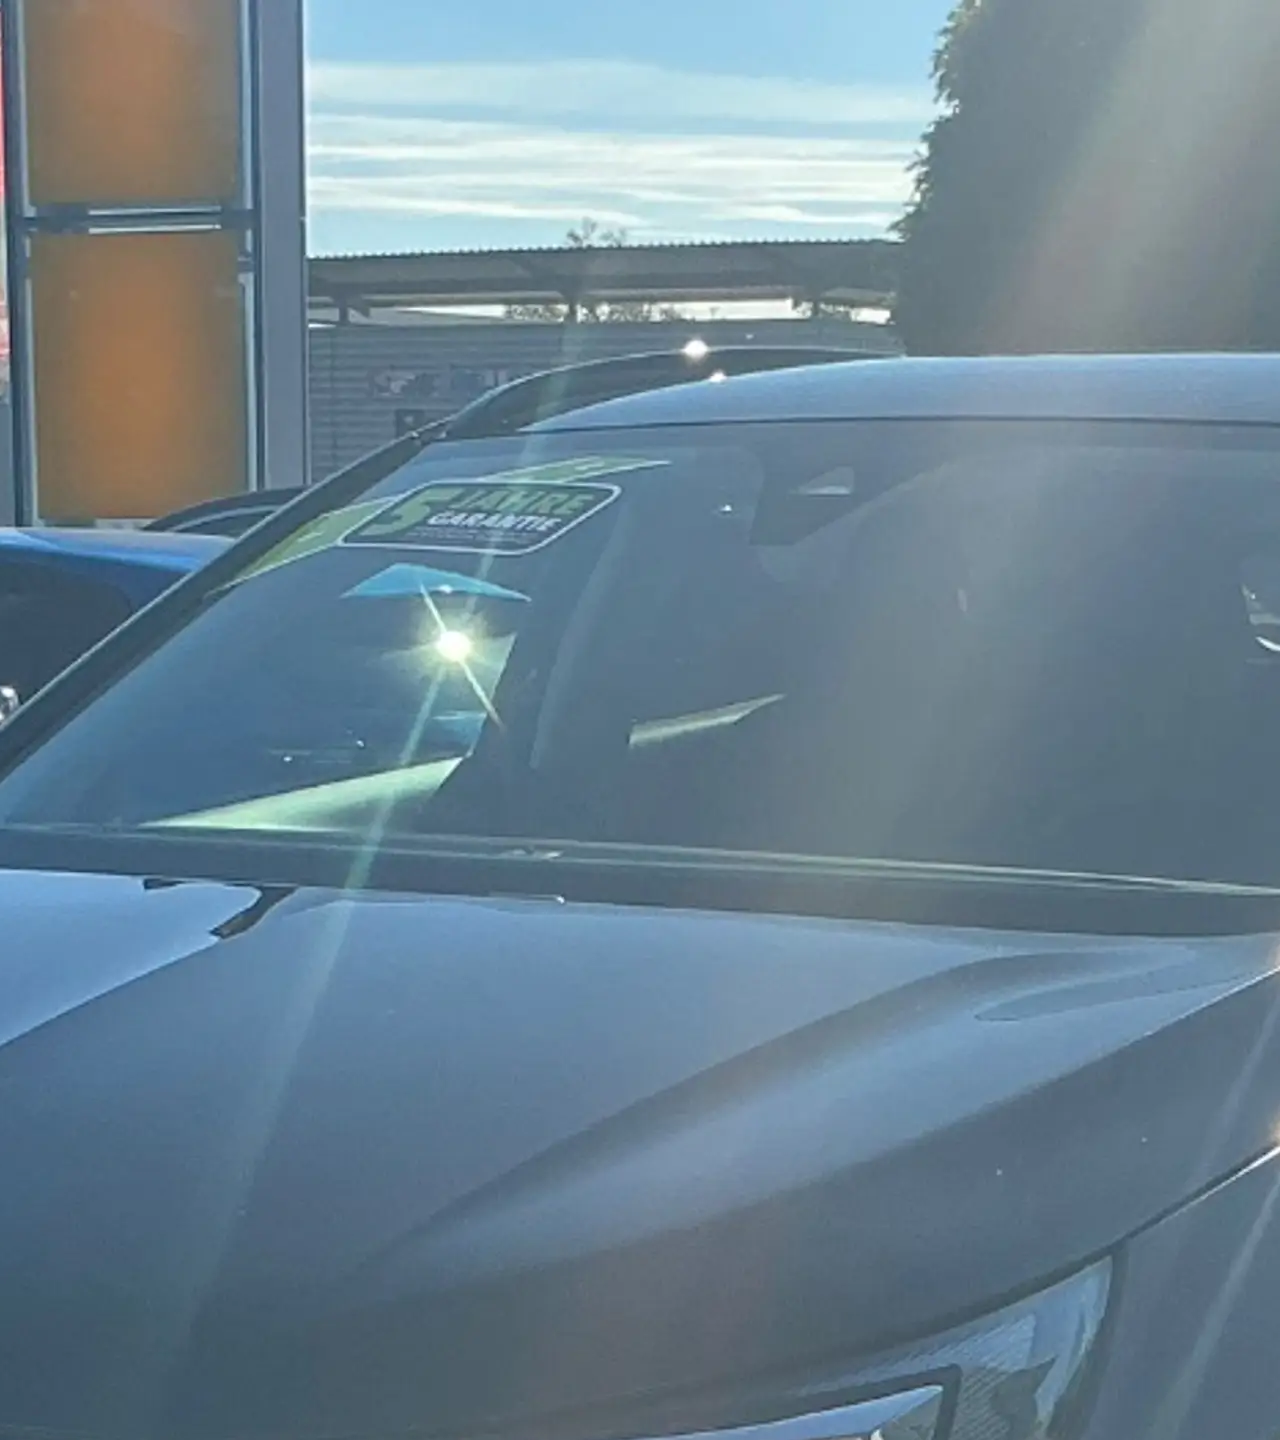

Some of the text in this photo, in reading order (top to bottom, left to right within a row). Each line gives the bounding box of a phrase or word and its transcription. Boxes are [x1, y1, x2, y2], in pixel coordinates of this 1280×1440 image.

[359, 486, 464, 536] 5
[448, 485, 595, 515] JAHRE
[427, 511, 562, 532] GARANTIE
